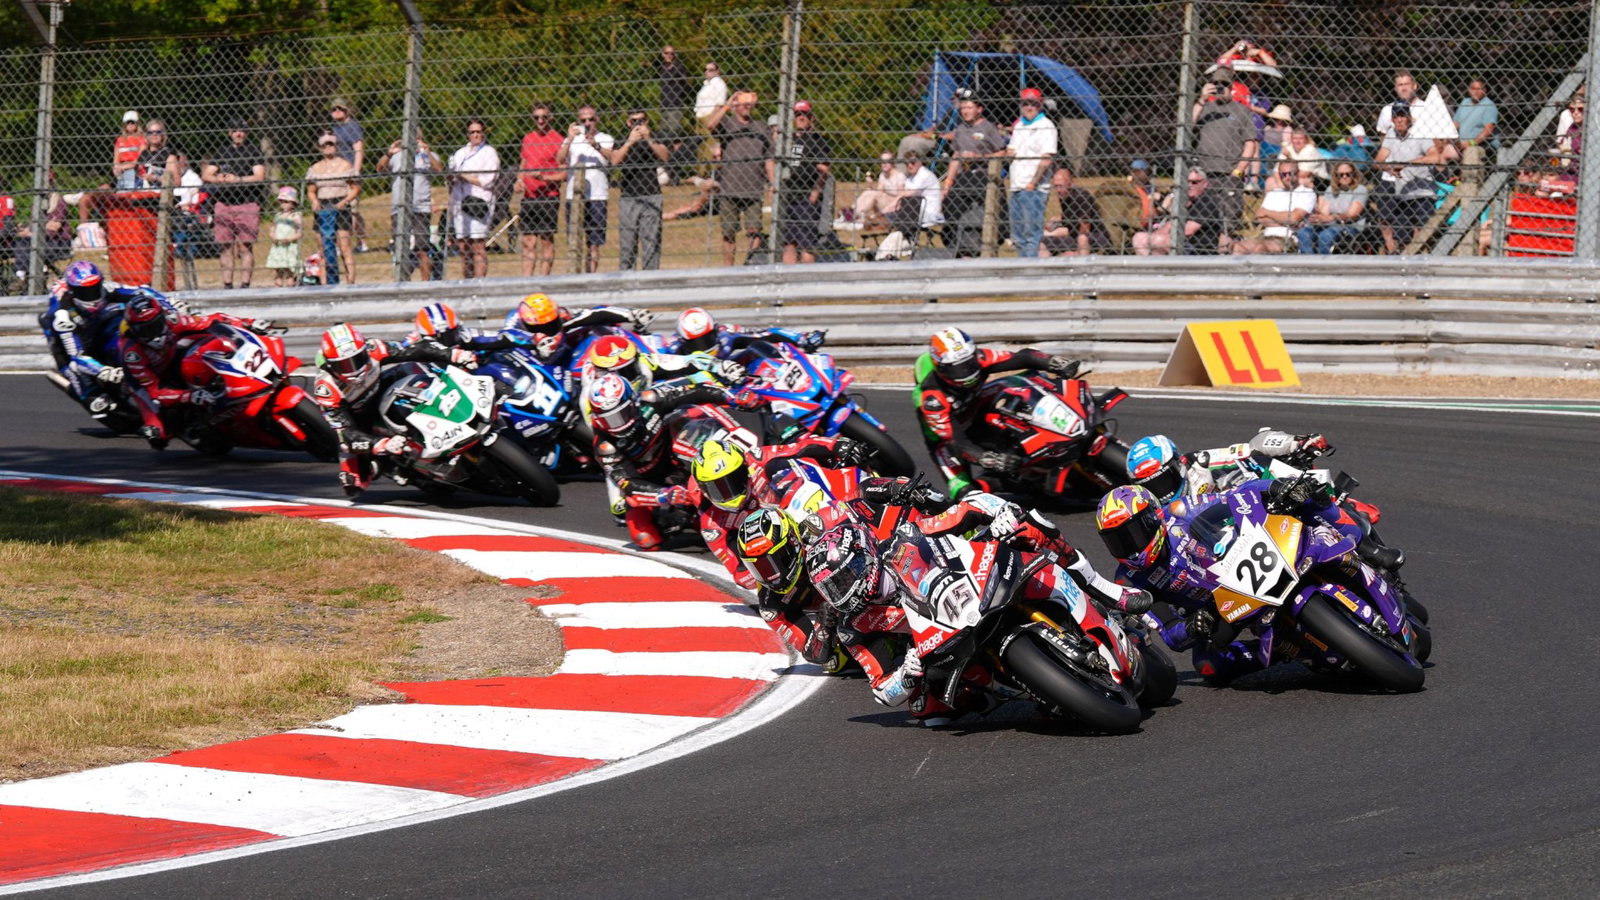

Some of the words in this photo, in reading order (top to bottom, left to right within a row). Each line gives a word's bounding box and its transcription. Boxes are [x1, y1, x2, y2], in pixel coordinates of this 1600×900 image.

[1210, 330, 1283, 383] LL
[1236, 541, 1278, 596] 28
[1226, 602, 1252, 621] YAMAHA
